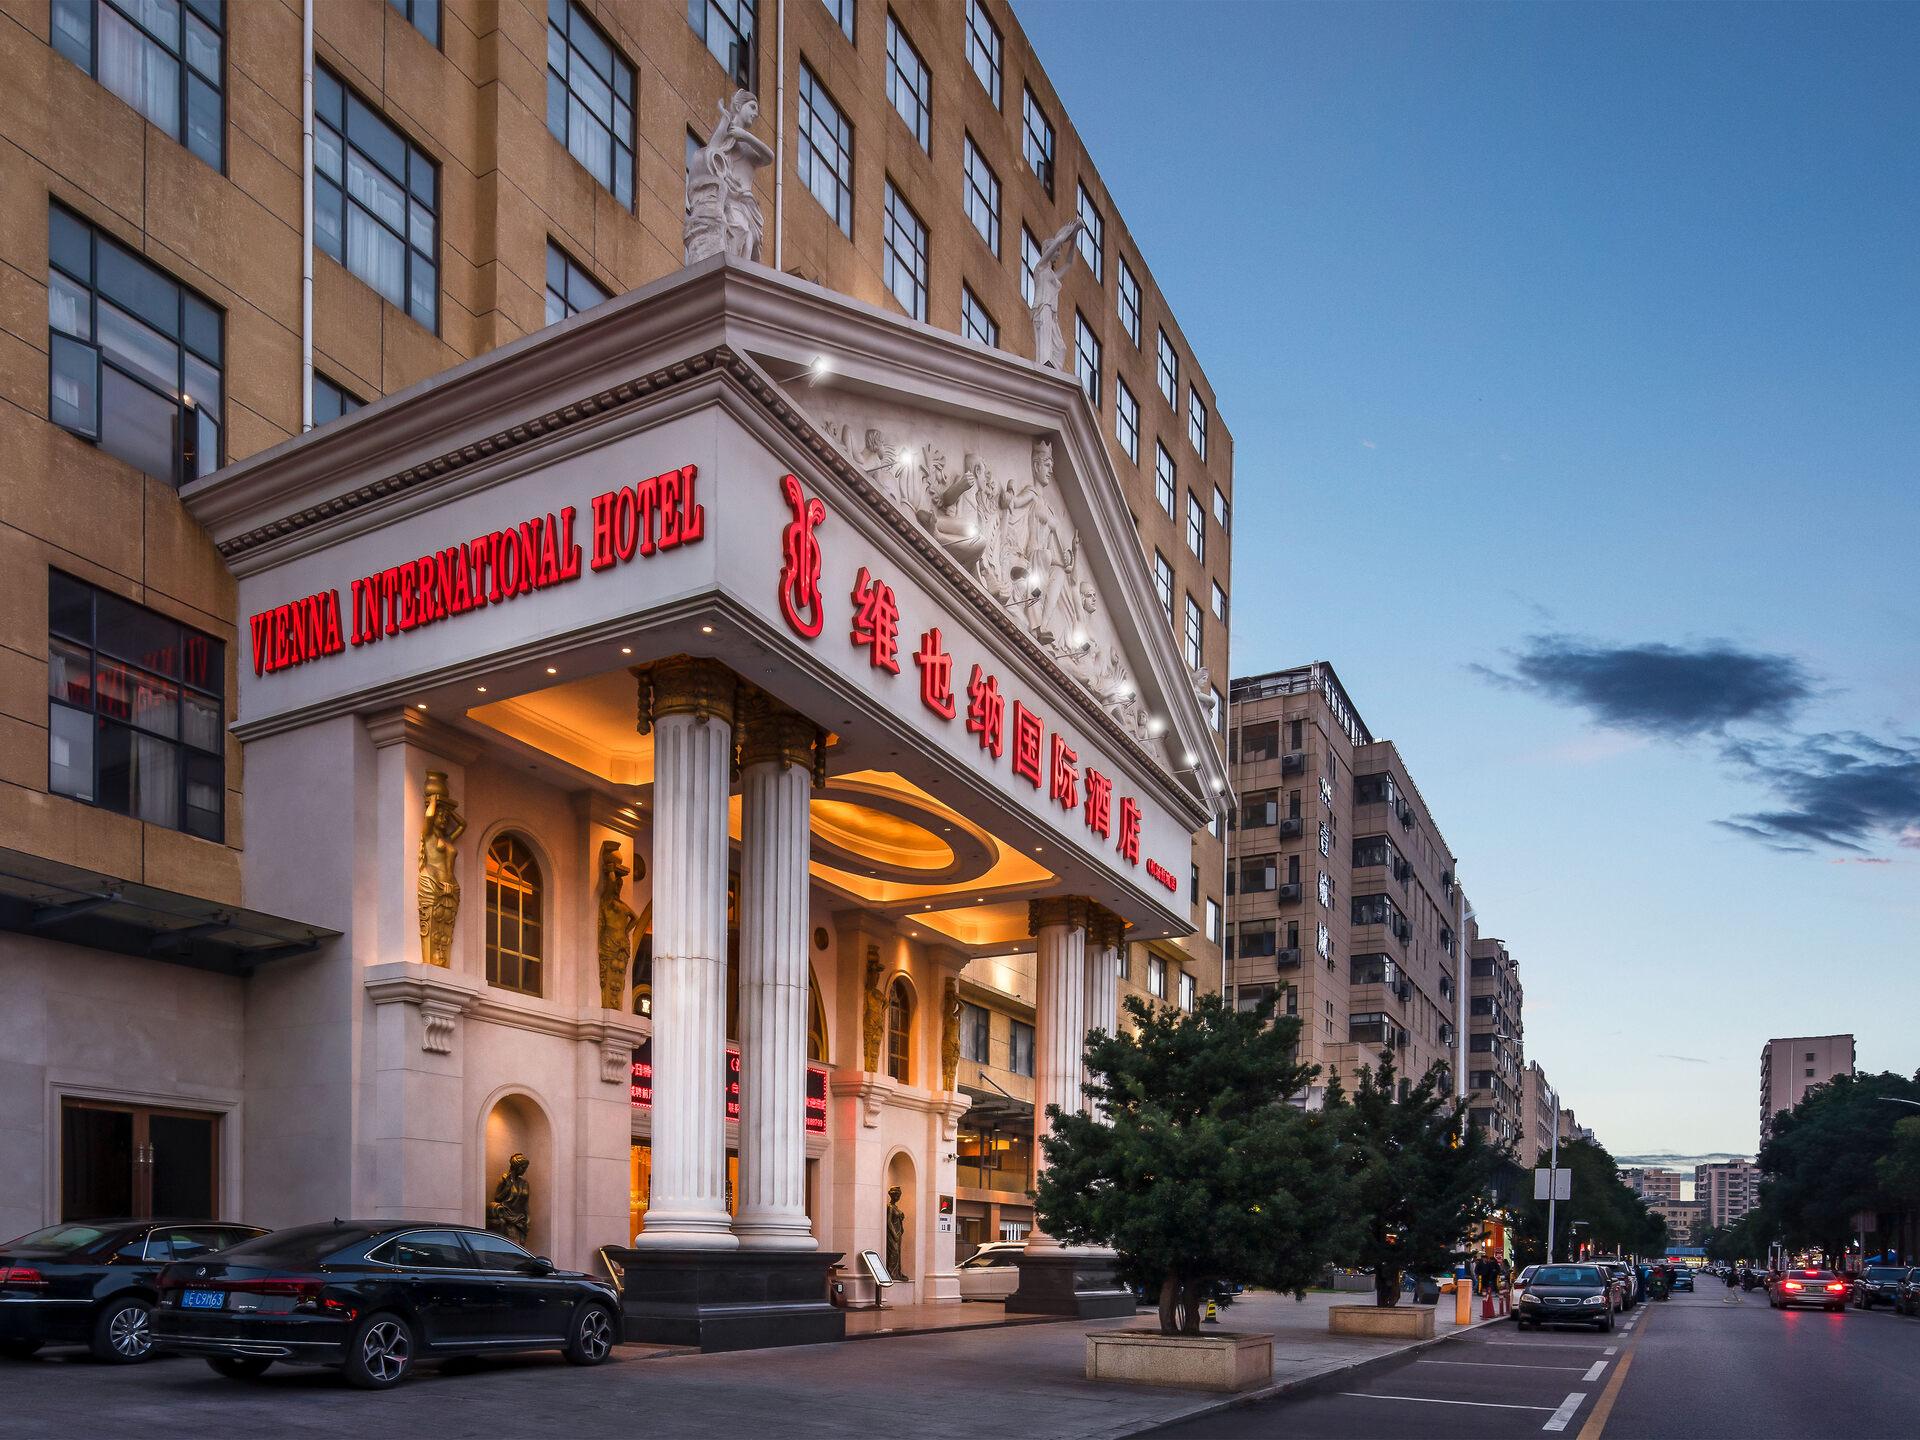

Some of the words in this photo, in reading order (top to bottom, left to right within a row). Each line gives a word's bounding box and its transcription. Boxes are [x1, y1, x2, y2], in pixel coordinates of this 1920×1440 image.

[249, 589, 345, 677] VIENNA
[350, 506, 582, 646] INTERNATIONAL
[591, 463, 704, 573] HOTEL
[850, 566, 1143, 866] 维也纳国际酒店
